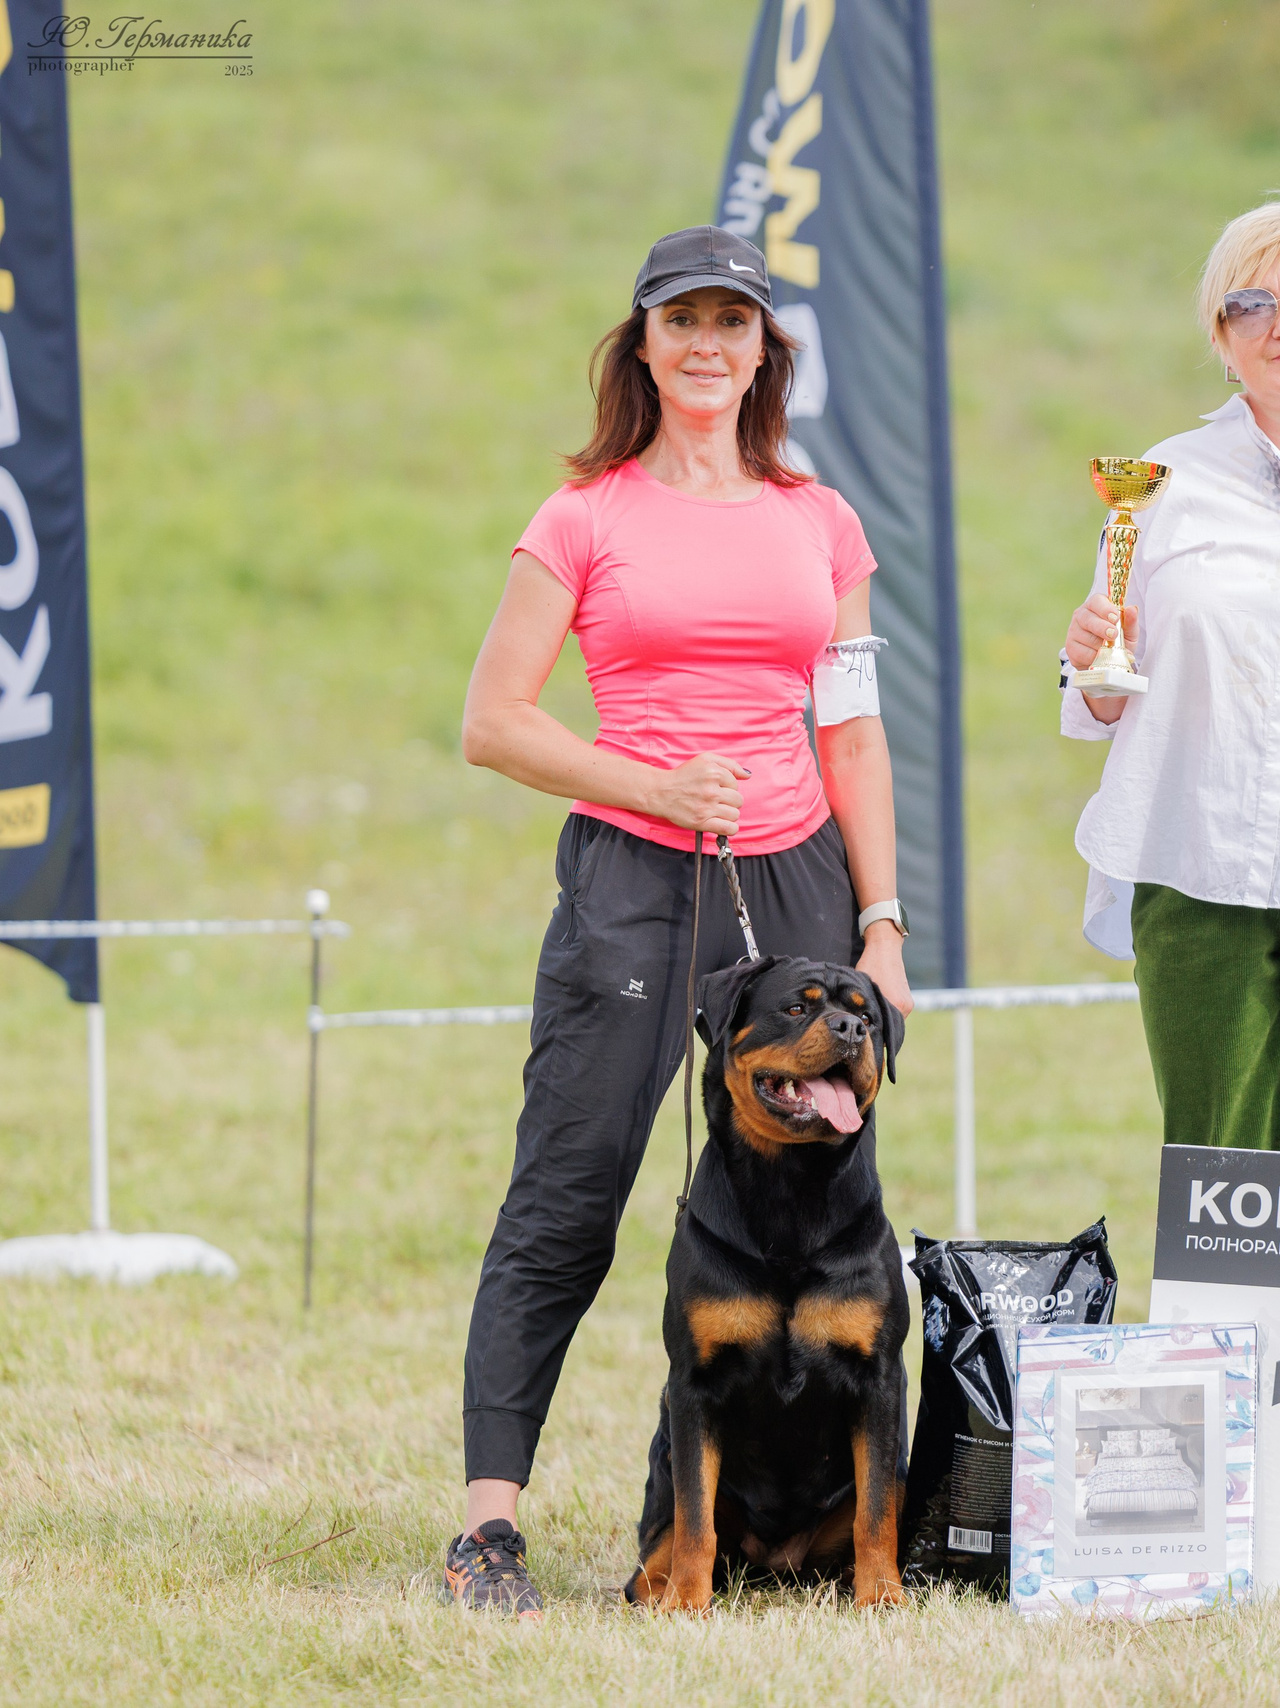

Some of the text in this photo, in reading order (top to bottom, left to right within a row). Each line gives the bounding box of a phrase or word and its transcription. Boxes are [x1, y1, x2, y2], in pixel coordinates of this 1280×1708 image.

[983, 1312, 1024, 1323] ЦИОННЫЙ
[1052, 1309, 1075, 1319] КОРМ
[1074, 1544, 1207, 1557] LUISA DE RIZZO
